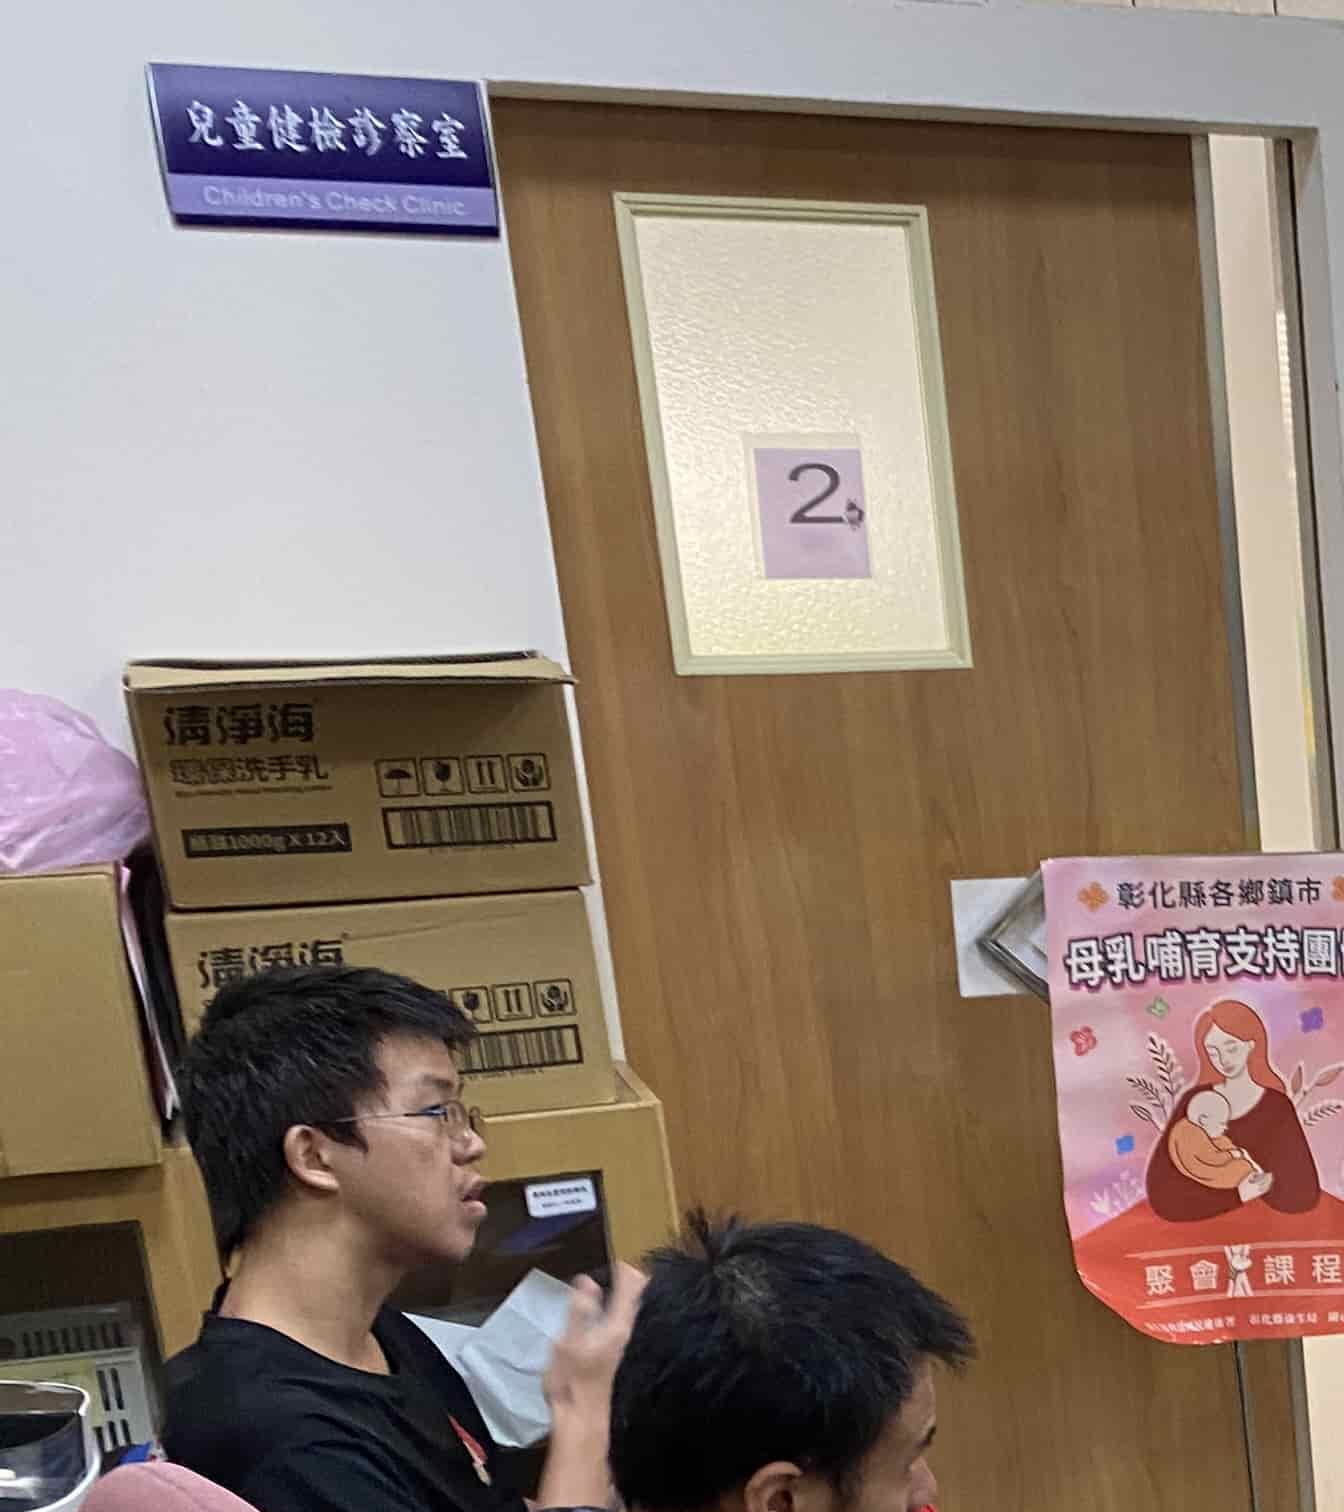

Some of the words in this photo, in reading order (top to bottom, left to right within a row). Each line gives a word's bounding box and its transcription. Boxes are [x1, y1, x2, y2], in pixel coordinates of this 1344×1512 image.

[185, 100, 468, 160] 兒童健檢診察室
[203, 185, 321, 210] Children's
[325, 190, 398, 213] Check
[402, 195, 466, 217] Clinic
[788, 463, 844, 524] 2
[163, 703, 314, 746] 清淨海
[1117, 877, 1322, 911] 彰化縣各鄉鎮市
[1144, 1259, 1219, 1297] 聚會
[1263, 1253, 1344, 1286] 課程
